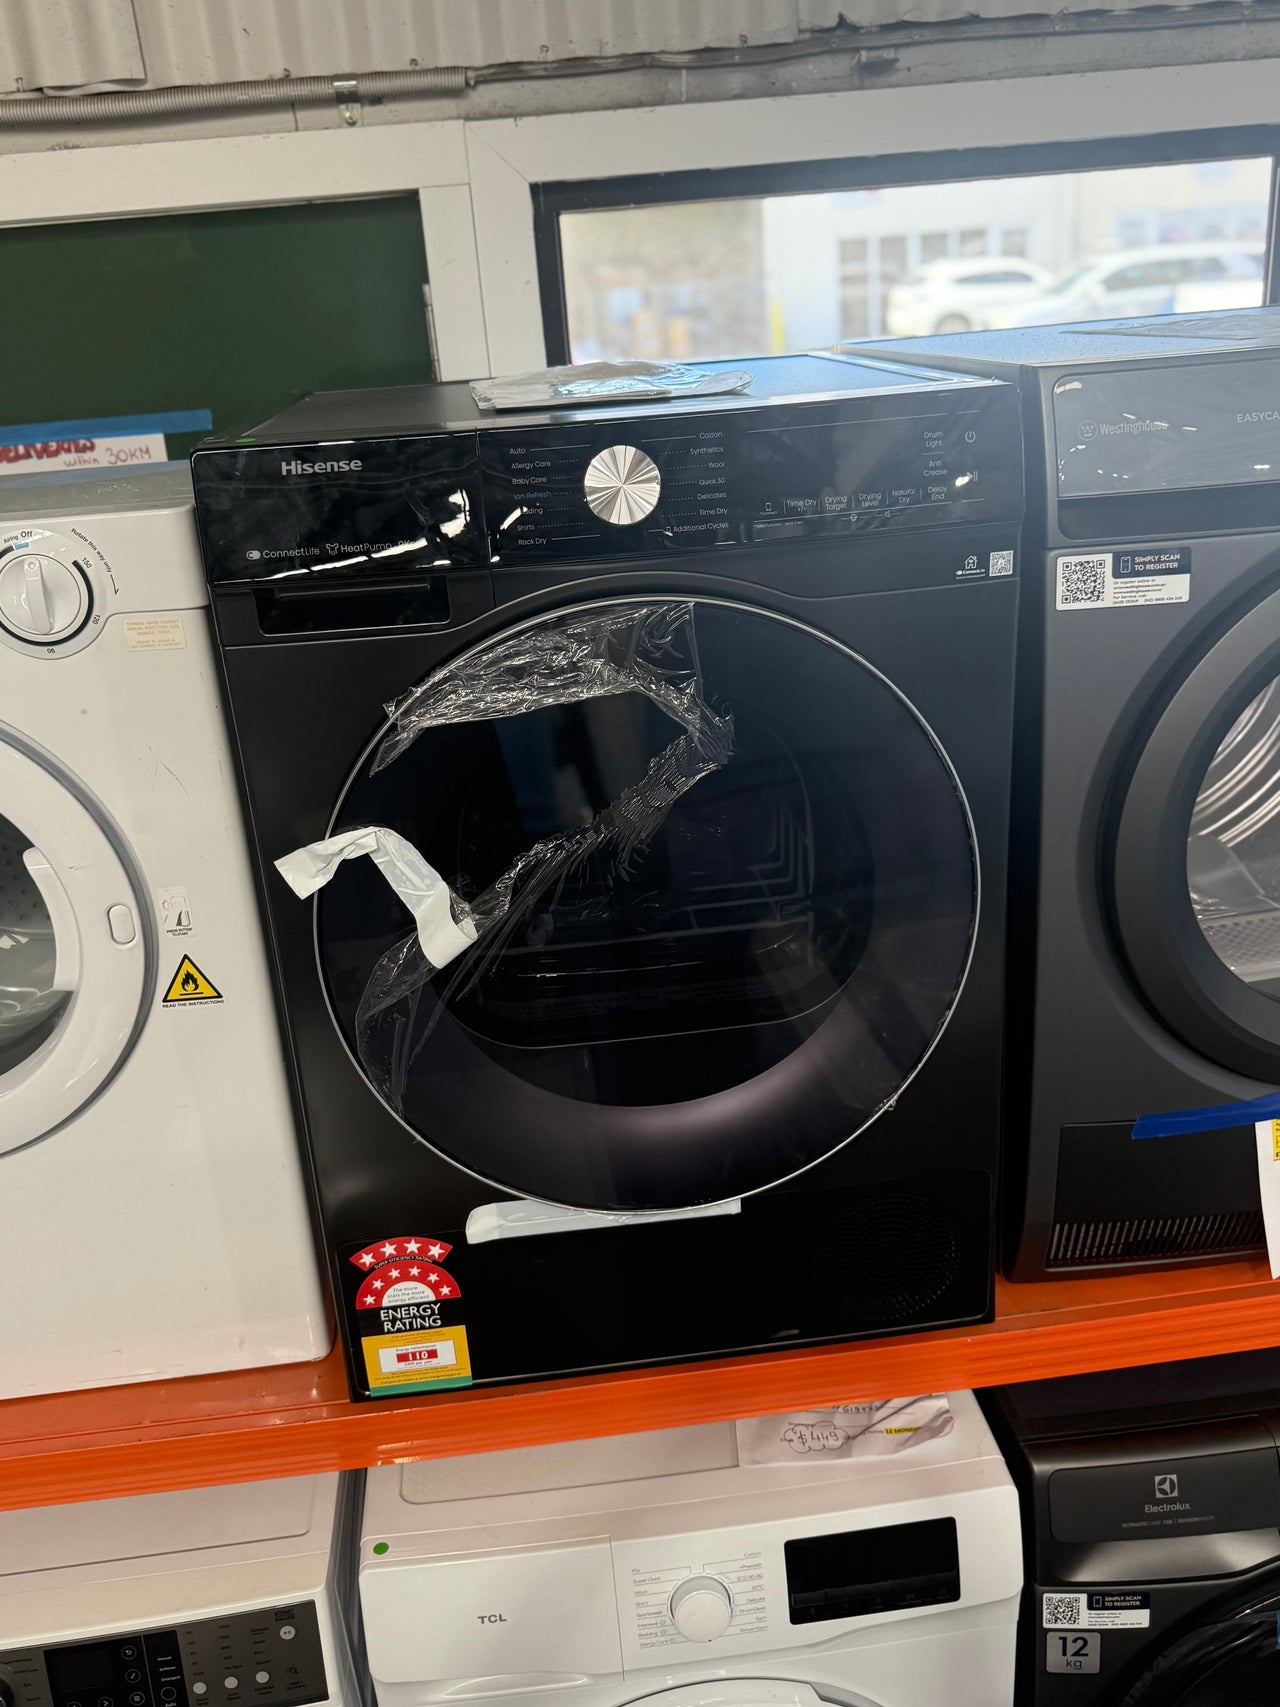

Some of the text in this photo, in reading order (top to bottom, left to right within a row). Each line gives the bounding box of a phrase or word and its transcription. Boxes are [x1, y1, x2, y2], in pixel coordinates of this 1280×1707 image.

[1237, 411, 1280, 423] EASYCA
[1099, 420, 1169, 435] Westinghouse
[699, 431, 723, 439] Cotton
[924, 431, 943, 439] Drum
[925, 439, 943, 448] Light
[509, 447, 526, 455] Auto
[690, 445, 724, 455] Synthetics
[64, 445, 152, 468] within 30KM
[281, 459, 363, 476] Hisense
[511, 459, 551, 470] Allergy Care
[708, 460, 725, 469] Wool
[923, 468, 948, 477] Crease
[512, 475, 547, 486] Baby Care
[699, 477, 716, 486] Quick
[525, 490, 552, 499] Refresh
[892, 488, 915, 496] Natural
[928, 485, 948, 495] Delay
[697, 491, 727, 500] Delicates
[825, 496, 847, 504] Drying
[858, 492, 882, 501] Drying
[898, 496, 910, 504] Dry
[931, 492, 945, 500] End
[787, 498, 817, 508] Time Dry
[826, 503, 847, 511] Target
[715, 507, 728, 516] Dry
[517, 523, 535, 531] Shirts
[673, 520, 729, 532] Additional Cycles
[3, 530, 33, 544] Airing Off
[534, 537, 547, 546] Dry
[71, 528, 113, 573] Rotate this way only
[262, 548, 320, 559] ConnectLife
[82, 557, 93, 569] 150
[1134, 555, 1159, 563] SIMPLY
[1146, 562, 1178, 570] REGISTER
[92, 613, 101, 625] 120
[374, 1260, 388, 1269] SUPER
[388, 1256, 414, 1264] EFFICIENCY
[380, 1302, 441, 1321] ENERGY
[384, 1315, 442, 1333] RATING
[408, 1351, 428, 1361] 110
[797, 1430, 839, 1447] $449
[1144, 1502, 1191, 1513] Electrolux
[477, 1613, 508, 1624] TCL
[1058, 1636, 1089, 1657] 12
[1066, 1658, 1082, 1670] kg
